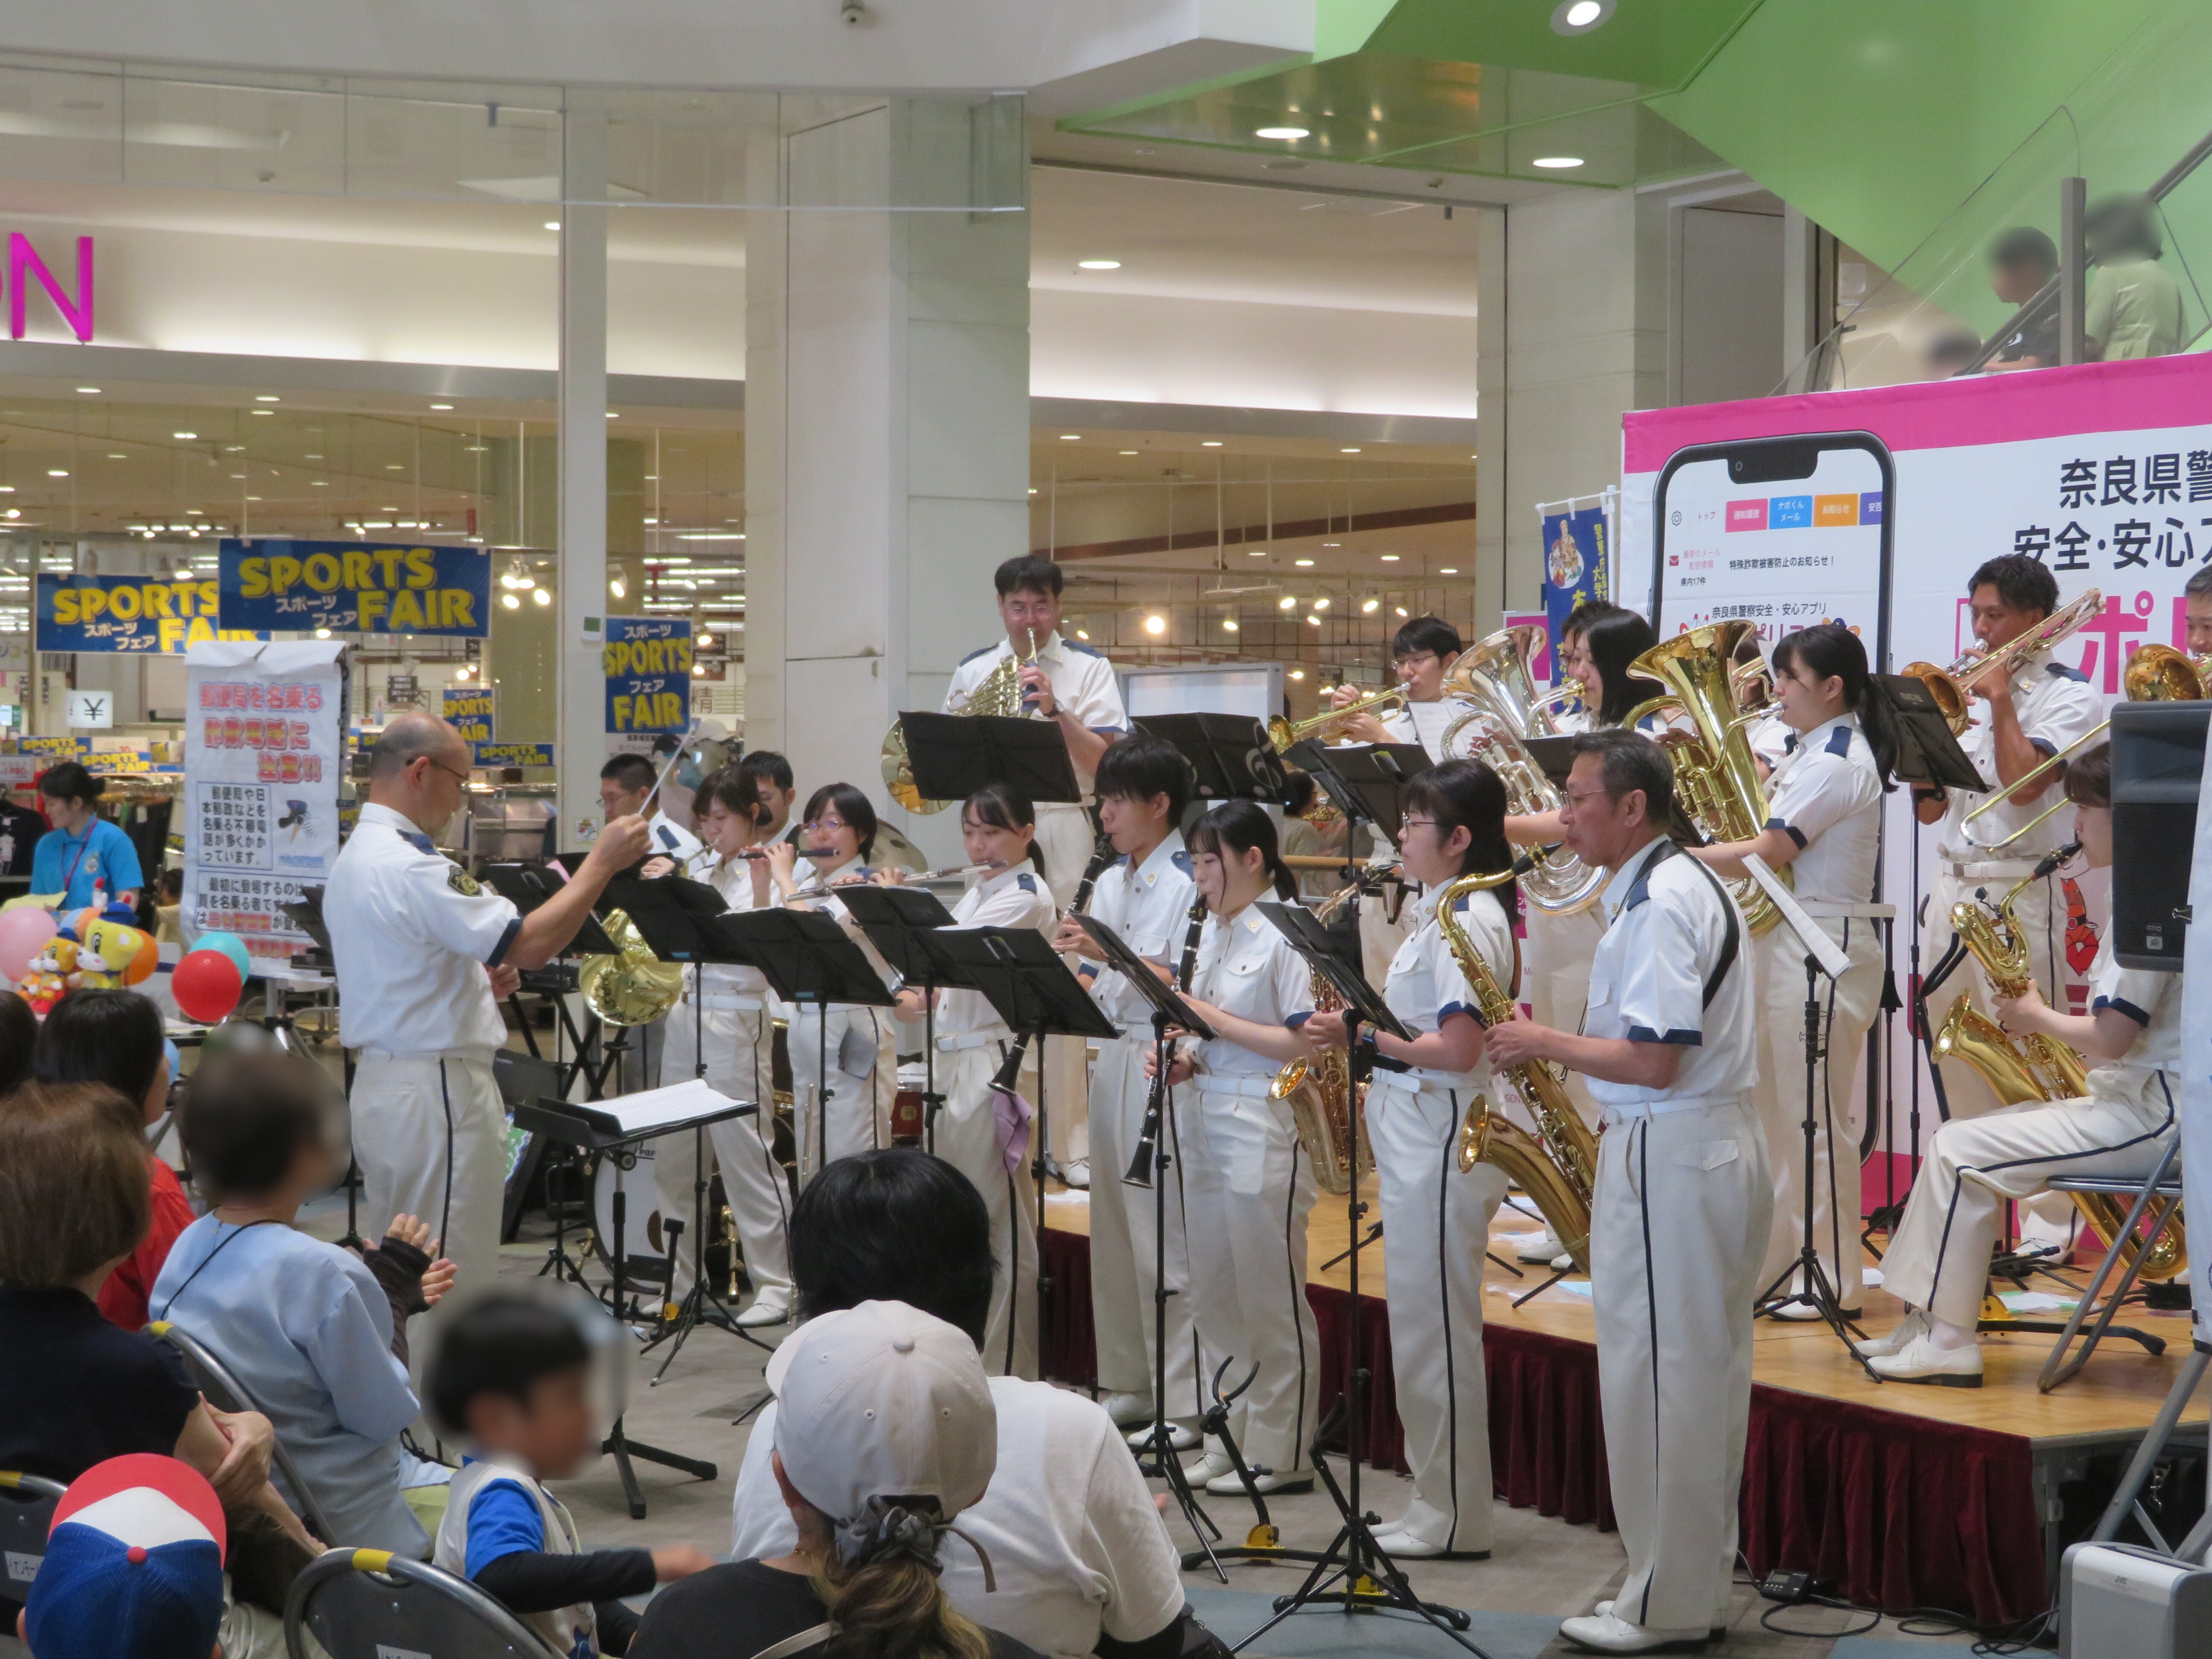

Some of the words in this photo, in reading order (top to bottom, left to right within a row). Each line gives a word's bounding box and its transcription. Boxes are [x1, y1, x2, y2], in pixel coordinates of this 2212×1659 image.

[0, 232, 93, 342] N
[1697, 511, 1716, 521] トップ
[1781, 512, 1801, 522] メール
[1822, 504, 1850, 515] お知らせ
[1683, 548, 1721, 559] 最新のメール
[1689, 560, 1714, 570] 配信情報
[239, 548, 437, 598] SPORTS
[1680, 576, 1707, 587] 県内17件
[53, 582, 218, 624] SPORTS
[276, 595, 337, 613] スポーツ
[357, 589, 477, 631] FAIR
[1712, 602, 1827, 619] 奈良県警察安全・安心アプリ
[312, 611, 358, 627] フェア
[84, 623, 138, 638] スポーツ
[624, 624, 672, 639] スポーツ
[115, 635, 156, 650] フェア
[605, 637, 691, 677] SPORTS
[629, 679, 665, 693] フェア
[200, 681, 324, 713] 郵便局を名乗る
[443, 697, 494, 717] SPORTS
[613, 692, 684, 731] FAIR
[454, 724, 489, 741] AIR
[480, 744, 537, 758] SPORTS
[82, 752, 139, 766] SPORTS
[514, 754, 549, 765] FAIR
[116, 761, 151, 773] FAIR
[212, 786, 265, 801] 郵便局や日
[203, 832, 267, 848] 話が多くかか
[205, 850, 260, 865] っています。
[198, 894, 294, 913] 員を名乗る者です
